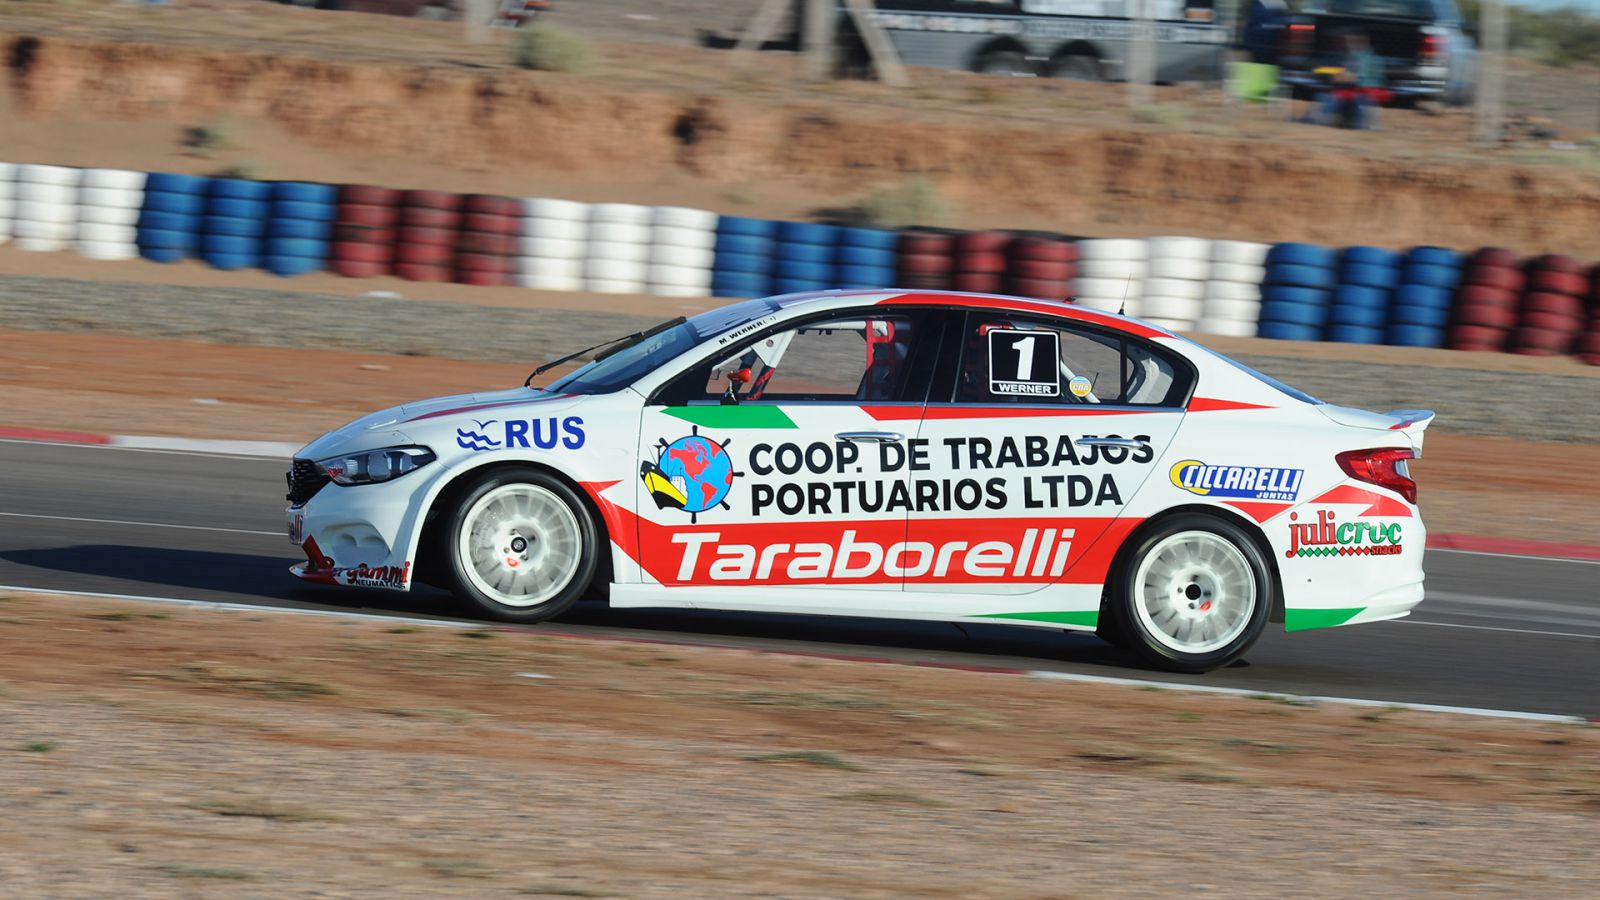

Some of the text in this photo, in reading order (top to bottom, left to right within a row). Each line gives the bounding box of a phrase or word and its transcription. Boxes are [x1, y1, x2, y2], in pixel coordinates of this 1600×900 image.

[728, 321, 763, 339] WERNER
[1012, 336, 1035, 380] 1
[998, 383, 1052, 394] WERNER
[505, 416, 585, 450] RUS
[749, 434, 1154, 475] COOP. DE TRABAJOS
[751, 473, 1123, 516] PORTUARIOS LTDA
[1183, 465, 1303, 493] CICCARELLI
[1256, 492, 1294, 500] JUNTAS
[1286, 510, 1402, 559] julicroc
[1370, 545, 1403, 556] snacks
[671, 528, 1075, 581] Taraborelli
